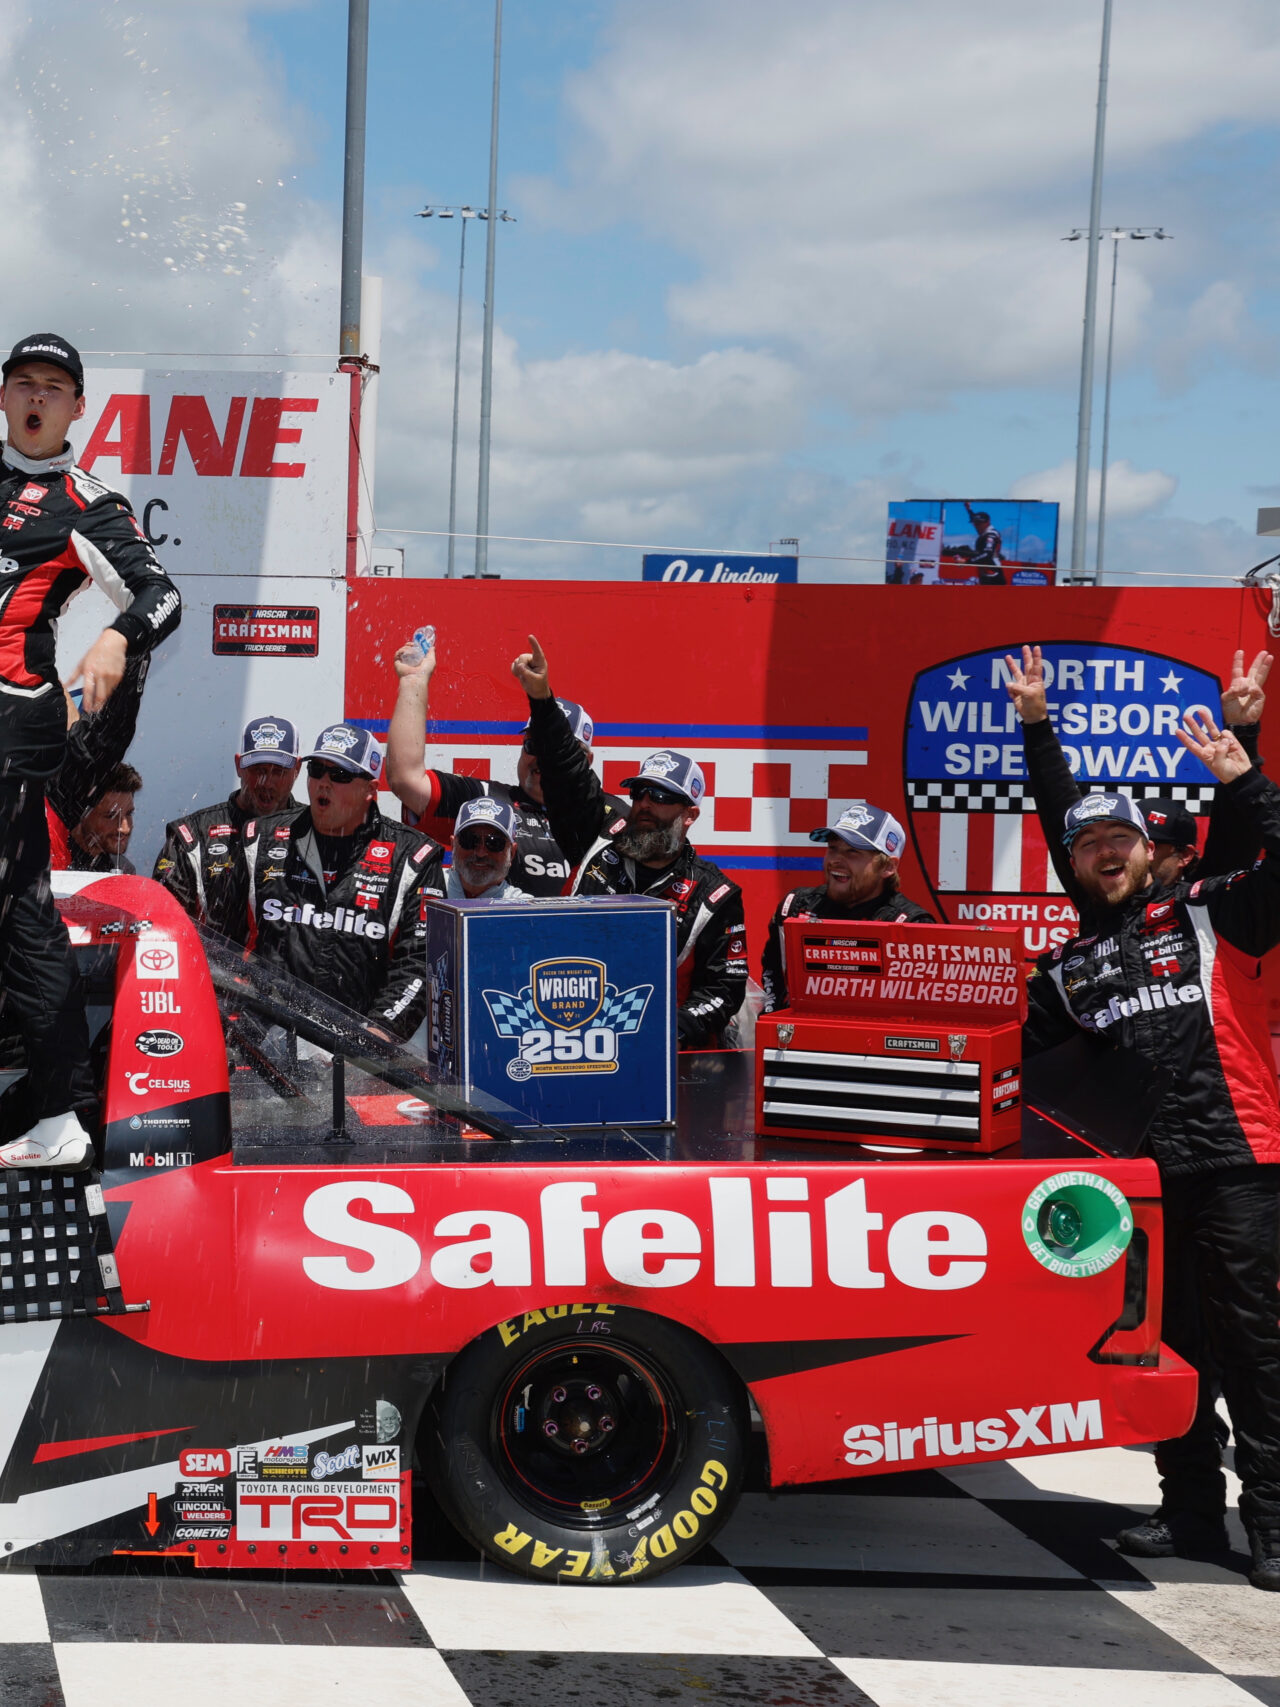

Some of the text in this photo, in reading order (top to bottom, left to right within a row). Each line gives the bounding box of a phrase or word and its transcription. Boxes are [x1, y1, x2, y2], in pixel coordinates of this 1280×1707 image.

[76, 394, 319, 479] ANE
[8, 501, 42, 517] TRD
[888, 522, 938, 541] LANE
[371, 565, 395, 577] ET
[147, 590, 180, 630] Safelit
[255, 610, 287, 619] NASCAR
[219, 623, 312, 639] CRAFTSMAN
[945, 743, 1187, 778] SPEDWAY
[262, 898, 386, 939] Safelite
[958, 903, 1038, 921] NORTH
[832, 939, 857, 947] NASCAR
[1024, 926, 1071, 951] US
[805, 948, 878, 962] CRAFTSMAN
[886, 943, 1011, 964] CRAFTSMAN
[888, 961, 1017, 984] 2024 WINNER
[539, 976, 598, 1002] WRIGHT
[805, 977, 1018, 1006] NORTH WILKESBORO
[140, 991, 181, 1014] JBL
[552, 1001, 585, 1009] BRAND
[1080, 983, 1203, 1033] Safelite
[522, 1027, 615, 1064] 250
[887, 1039, 937, 1050] CRAFTSMAN
[148, 1079, 190, 1089] CELSIUS
[10, 1152, 42, 1161] Safelite
[130, 1152, 174, 1167] Mobil
[1027, 1173, 1126, 1210] GET BIOETHANOL
[302, 1177, 988, 1291] Safelite
[1029, 1241, 1125, 1277] GET BIOETHANOL
[844, 1398, 1103, 1467] SiriusXM
[264, 1446, 308, 1457] HMS
[366, 1449, 396, 1467] WIX
[185, 1454, 224, 1472] SEM
[263, 1457, 307, 1465] motorsport
[182, 1484, 224, 1493] DRIVEN
[240, 1484, 396, 1494] TOYOTA RACING DEVELOPMENT
[177, 1503, 221, 1511] LINCOLN
[240, 1495, 397, 1540] TRD
[176, 1527, 229, 1538] COMETIC
